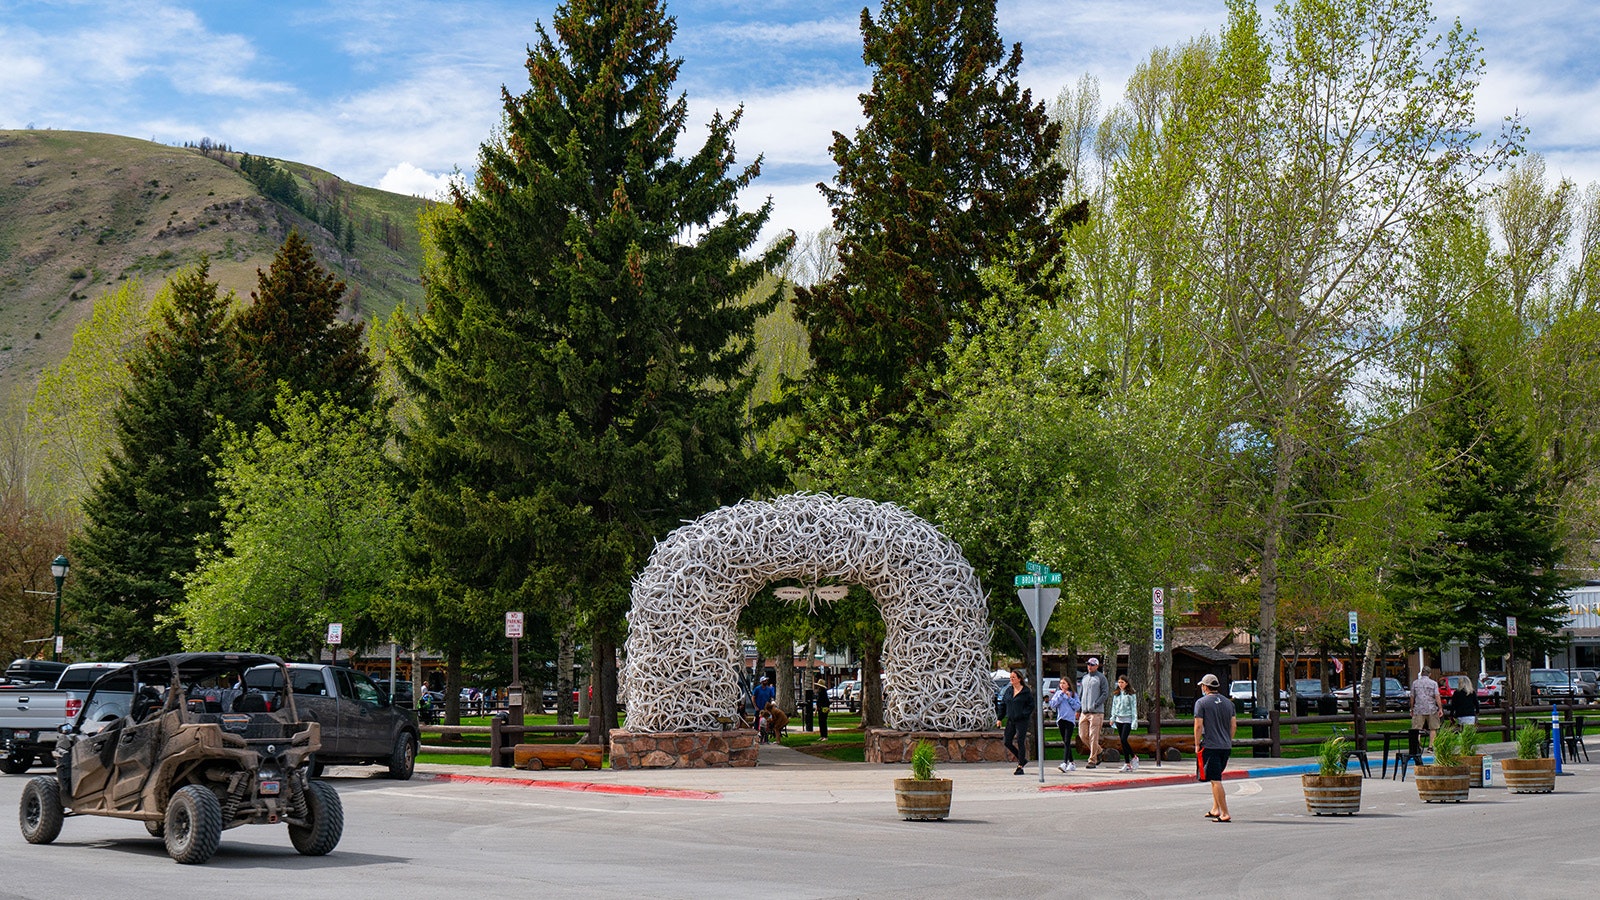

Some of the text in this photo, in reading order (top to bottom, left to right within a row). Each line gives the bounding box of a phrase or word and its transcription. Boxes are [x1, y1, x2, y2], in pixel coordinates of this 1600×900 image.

[1027, 562, 1049, 574] CENTER ST
[1014, 573, 1061, 584] E BROADWAY AVE
